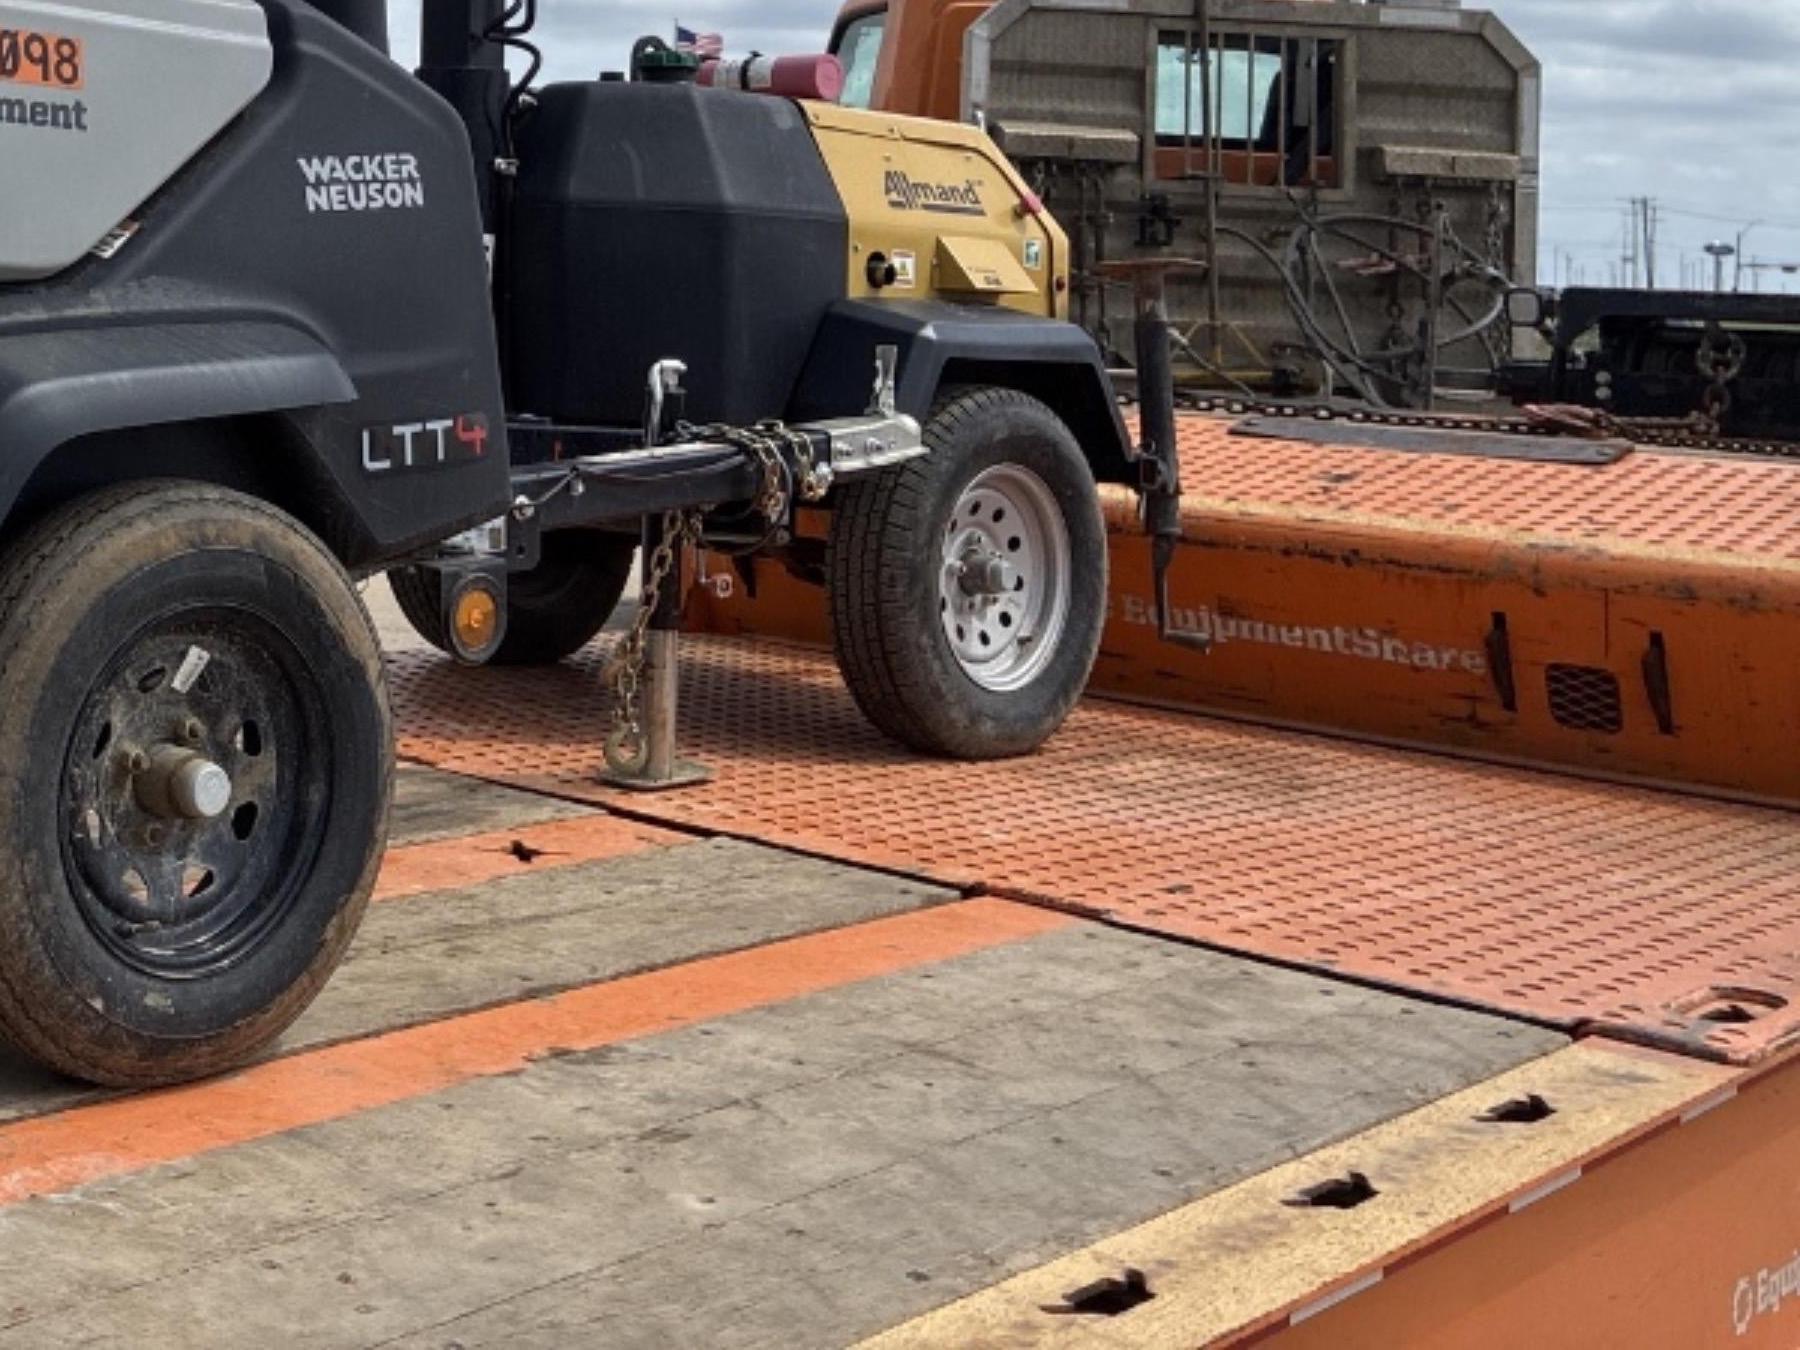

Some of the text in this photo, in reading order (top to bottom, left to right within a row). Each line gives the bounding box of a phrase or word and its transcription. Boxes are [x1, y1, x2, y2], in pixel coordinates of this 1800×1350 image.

[296, 152, 421, 184] WACKER
[305, 180, 425, 213] NEUSON
[884, 170, 981, 209] Allmand
[361, 411, 488, 472] LTT4
